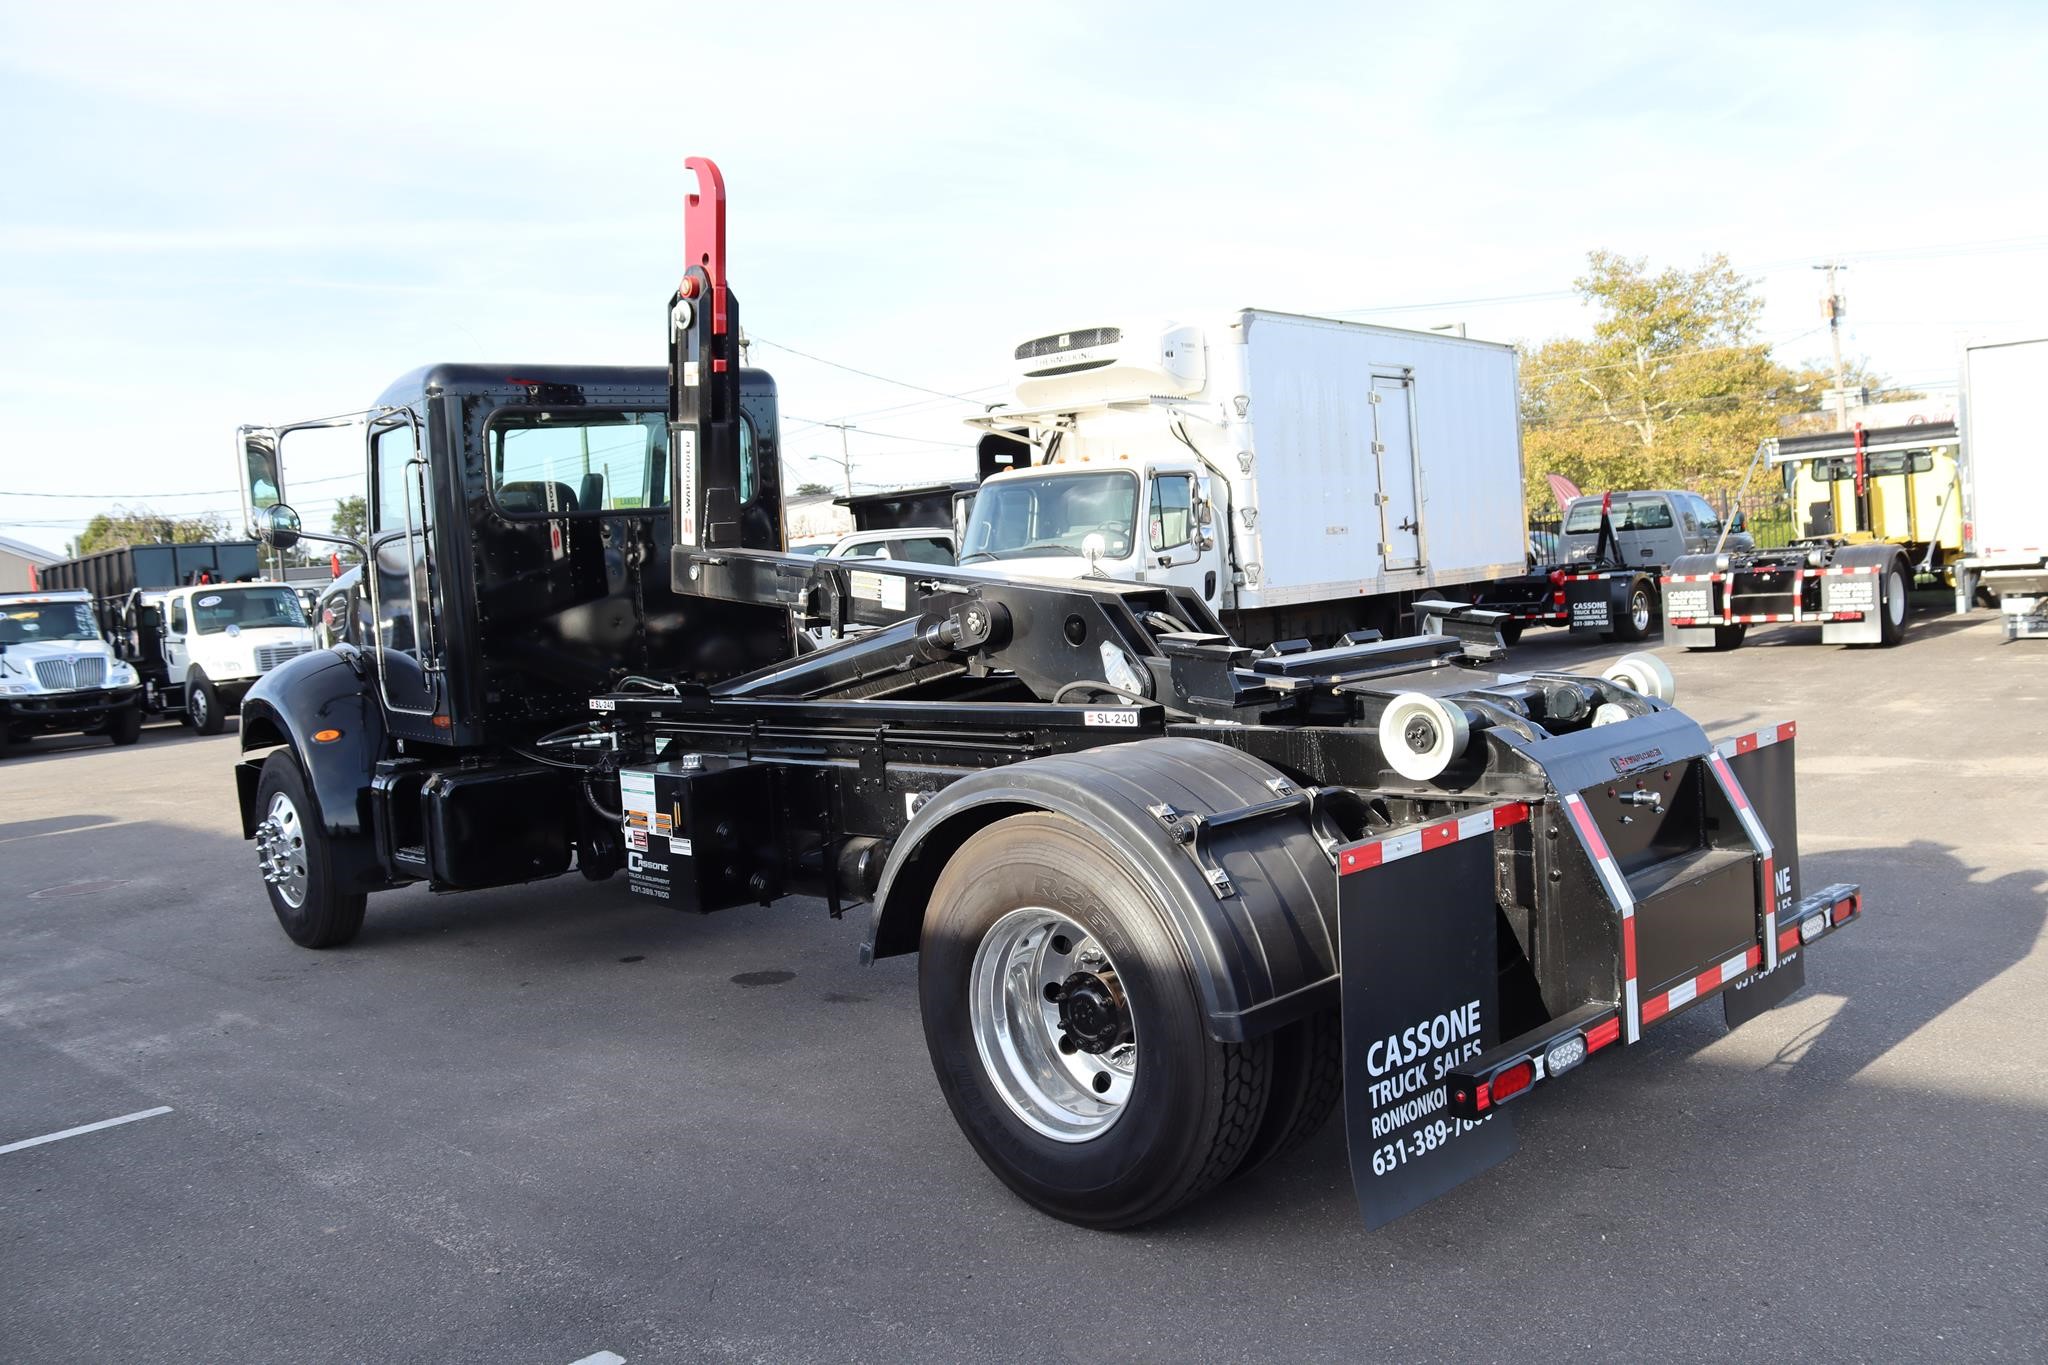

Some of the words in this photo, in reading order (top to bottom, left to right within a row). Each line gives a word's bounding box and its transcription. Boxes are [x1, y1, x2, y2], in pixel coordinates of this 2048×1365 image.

[1573, 601, 1607, 610] CASSONE
[1366, 999, 1482, 1077] CASSONE
[1368, 1062, 1428, 1109] TRUCK
